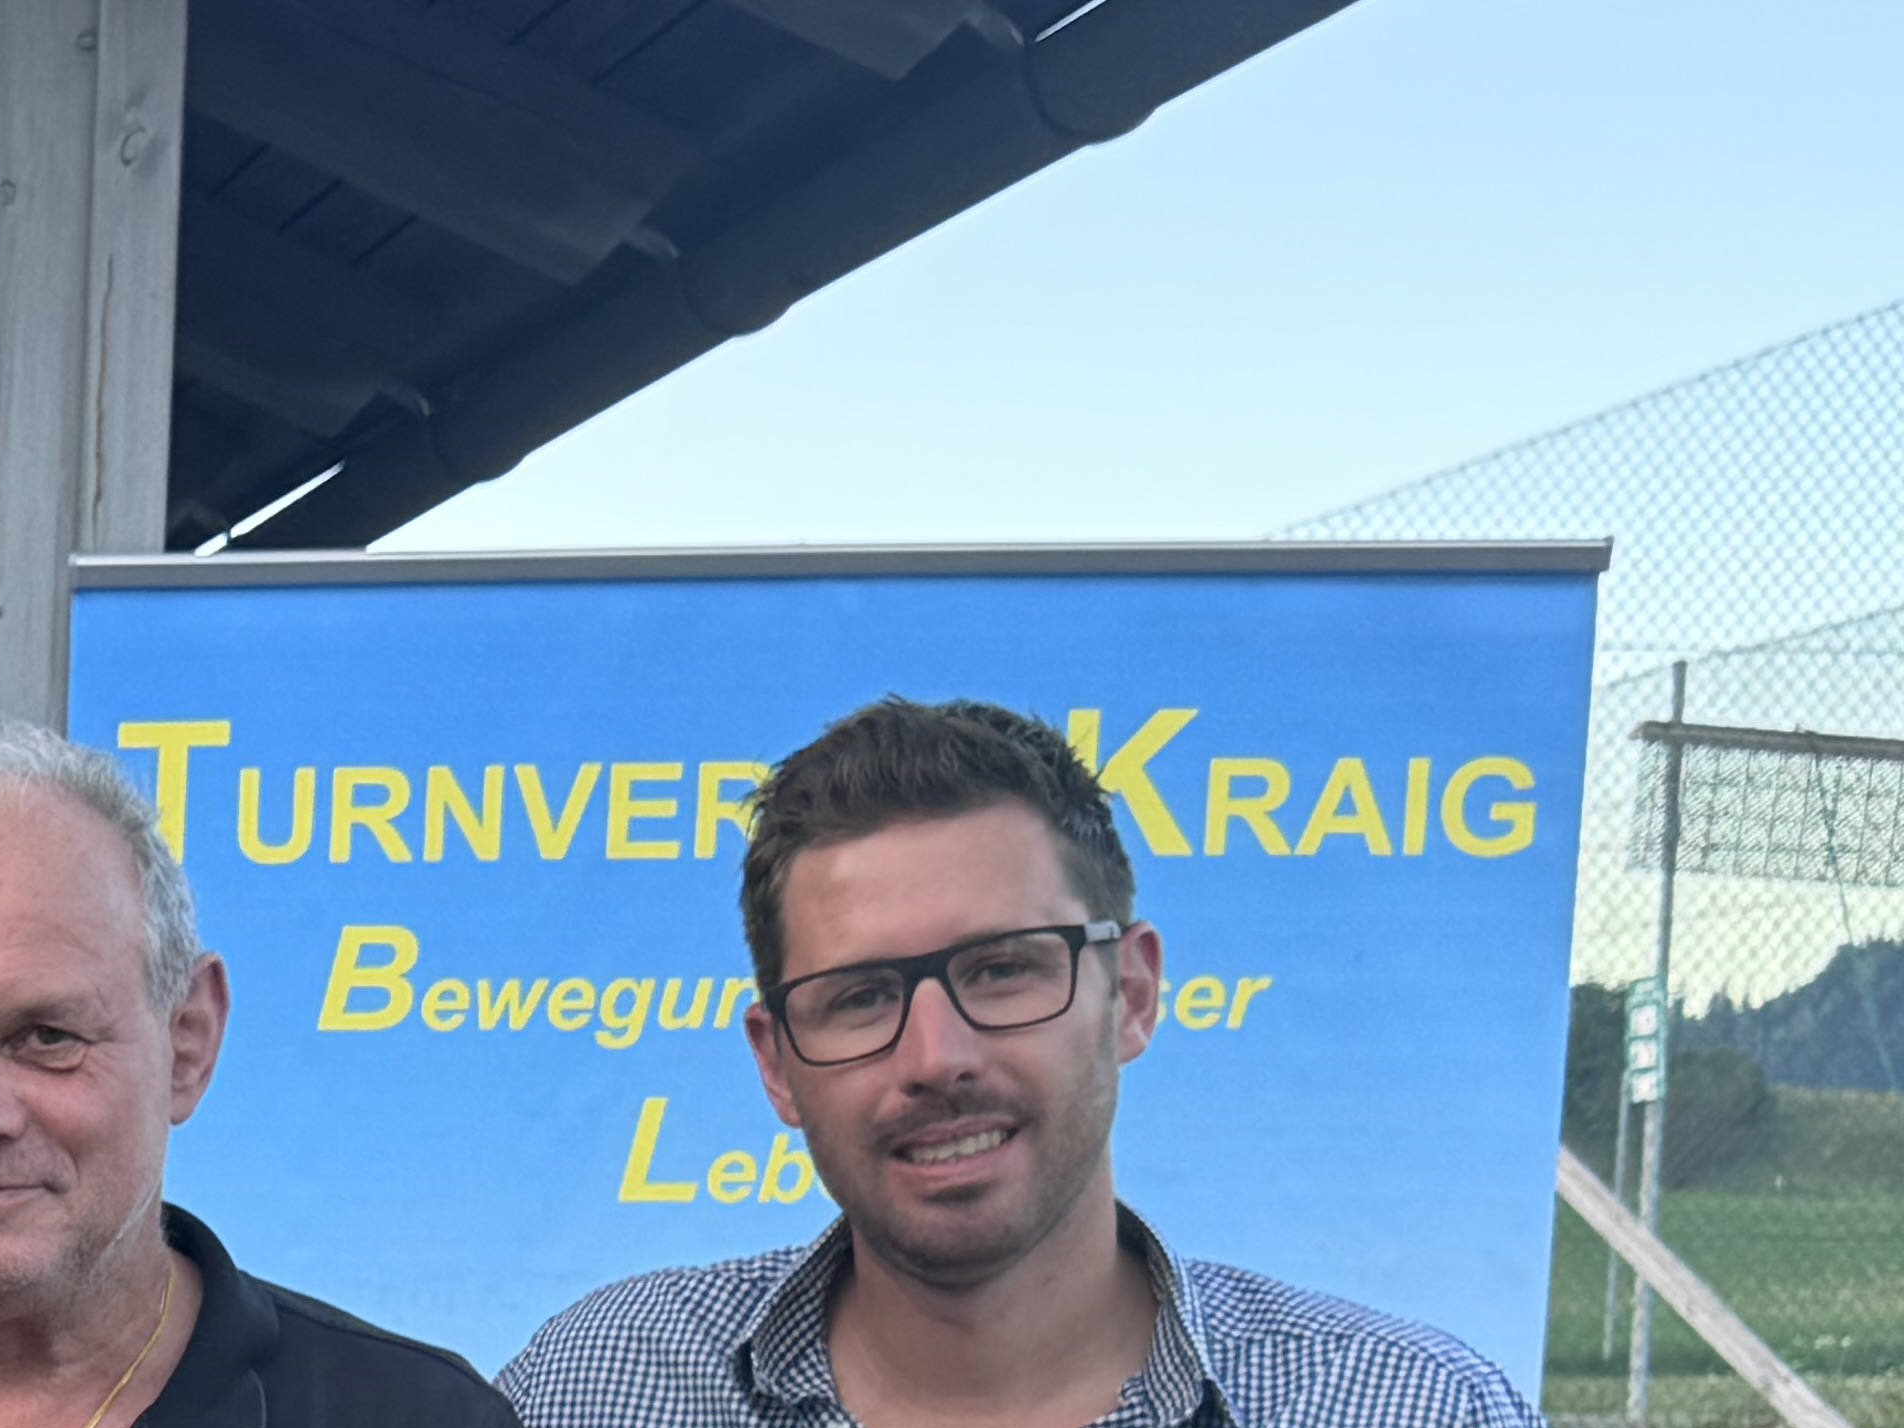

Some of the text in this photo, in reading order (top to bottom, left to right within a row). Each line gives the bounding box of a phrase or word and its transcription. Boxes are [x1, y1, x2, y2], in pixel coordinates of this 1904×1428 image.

[117, 707, 1538, 865] TURNVER KRAIG
[317, 924, 1273, 1050] Bewegun er
[618, 1096, 834, 1206] Leb
